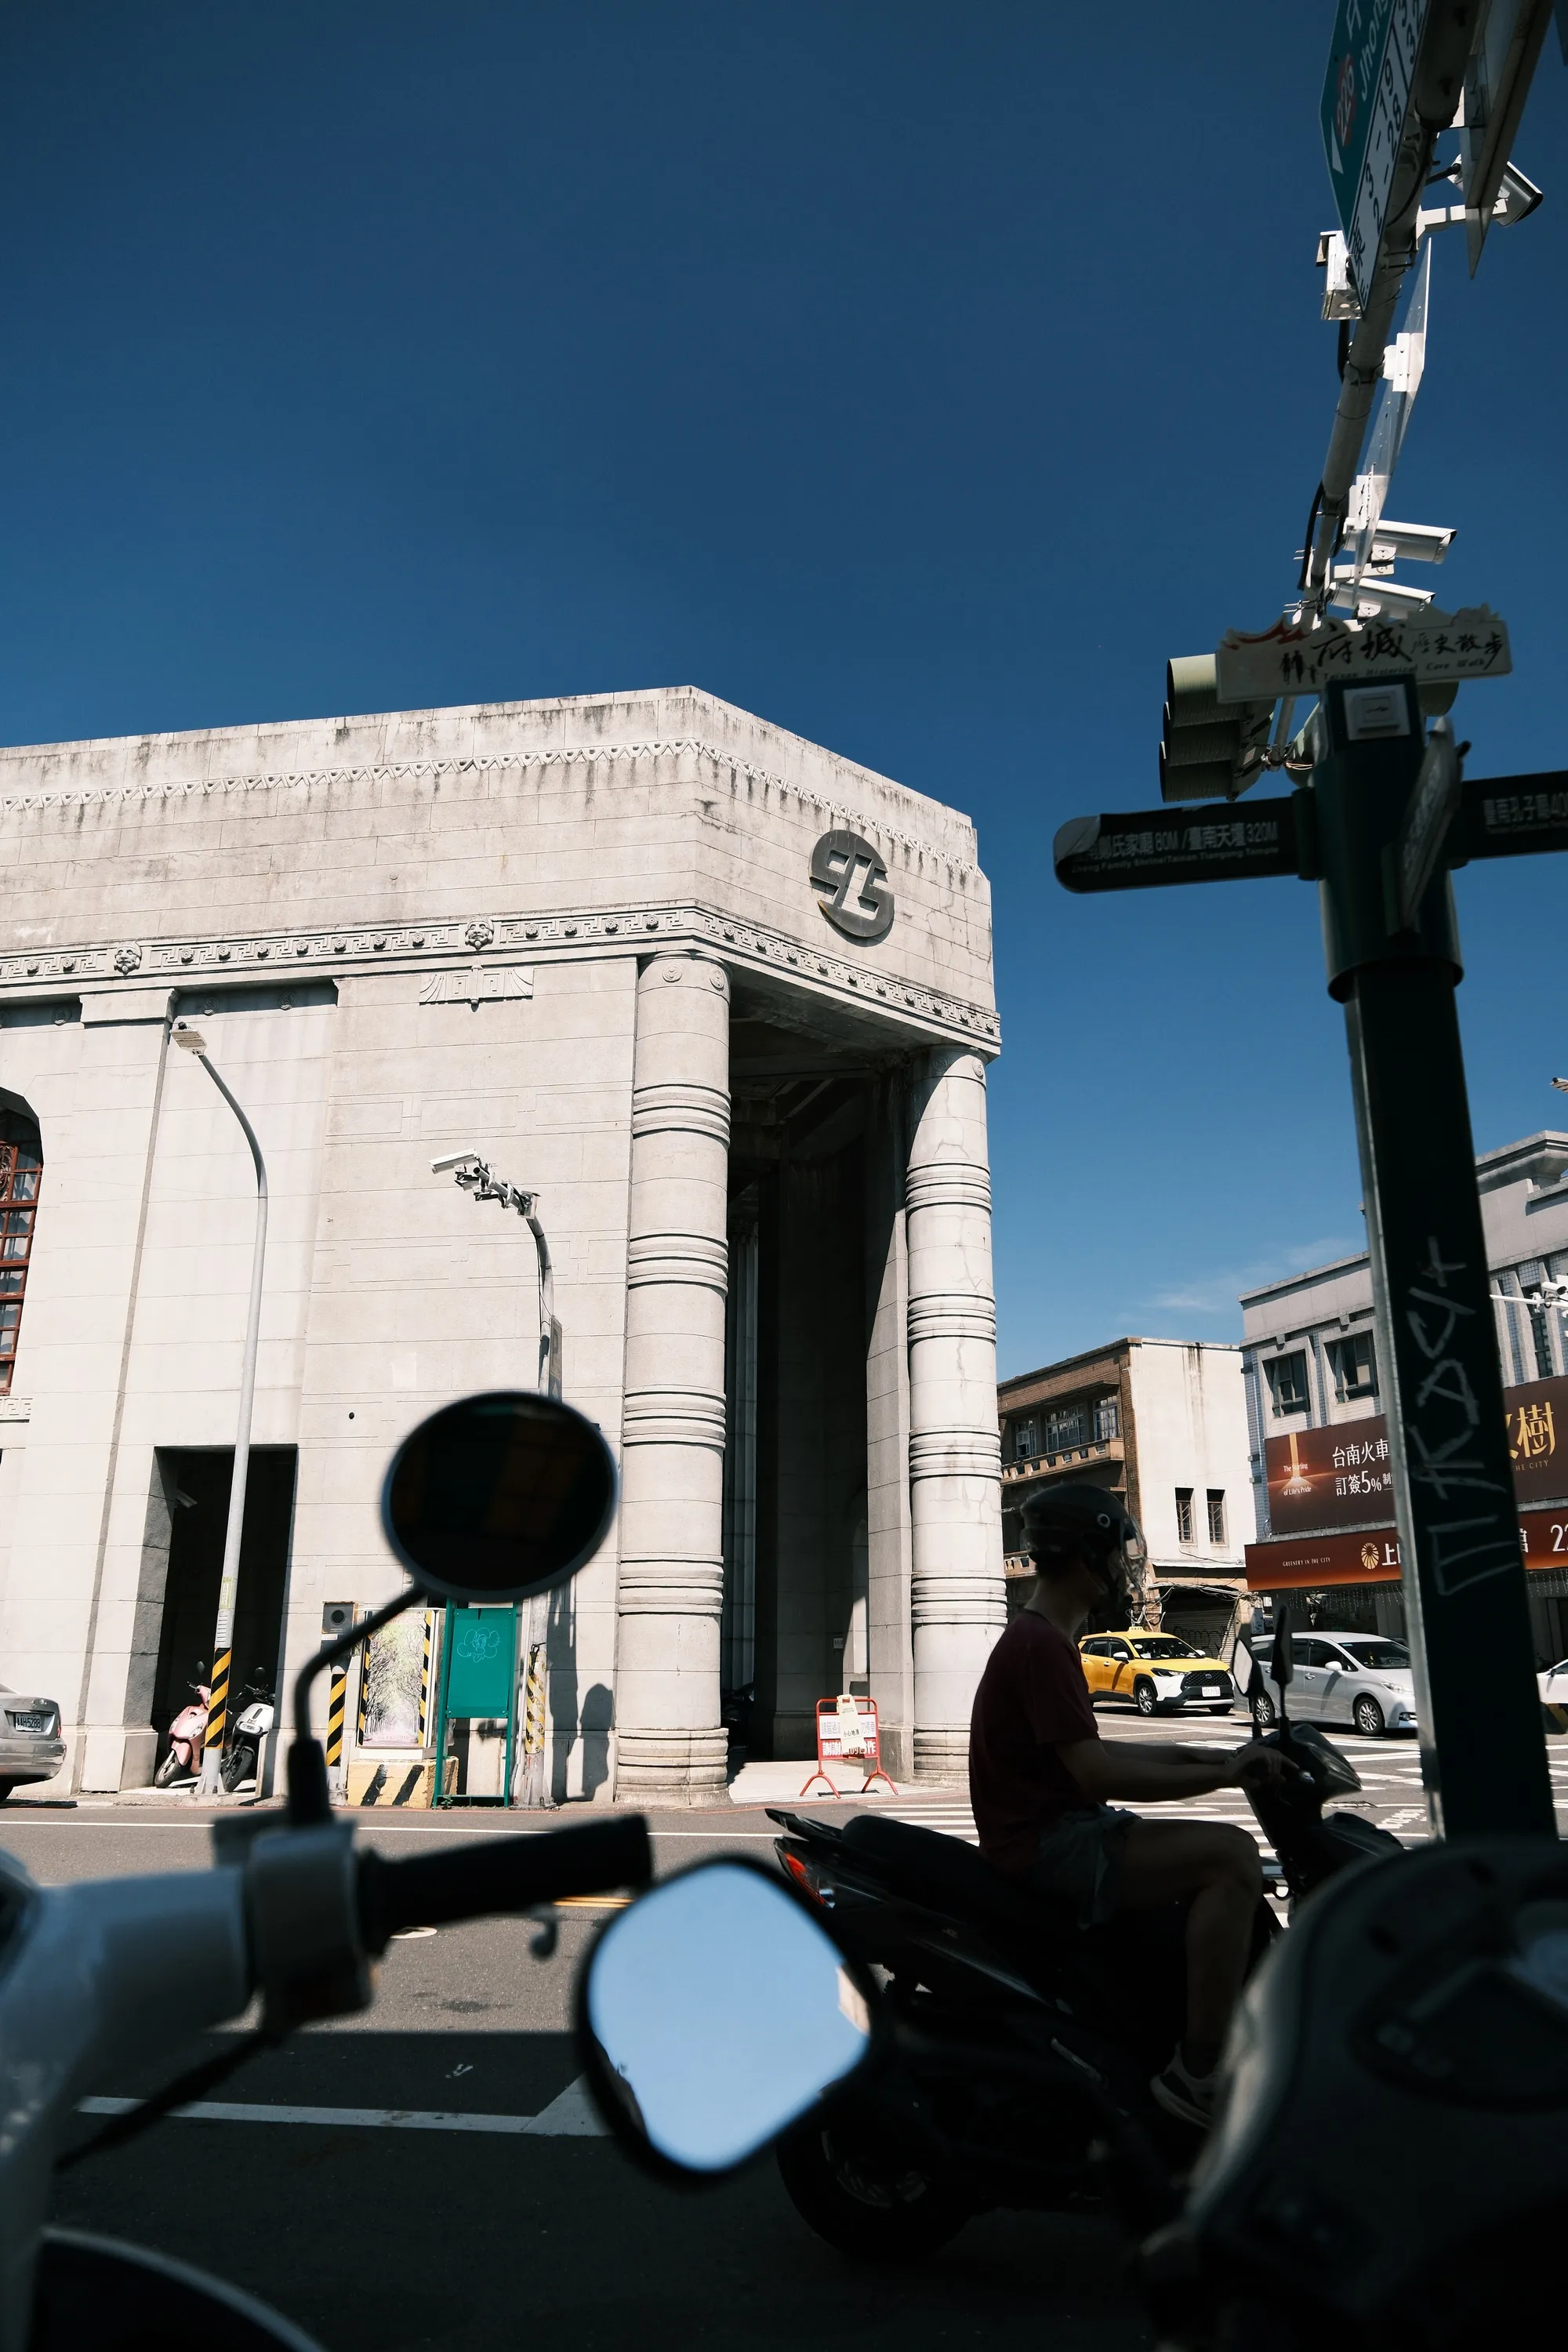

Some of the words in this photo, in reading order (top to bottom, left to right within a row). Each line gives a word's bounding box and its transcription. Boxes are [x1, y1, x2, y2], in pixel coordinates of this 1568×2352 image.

[1359, 0, 1388, 102] Jhon
[1332, 1438, 1391, 1468] 台南火車
[1530, 1459, 1550, 1470] CITY
[1551, 1524, 1568, 1552] 2
[1381, 1542, 1401, 1566] 上
